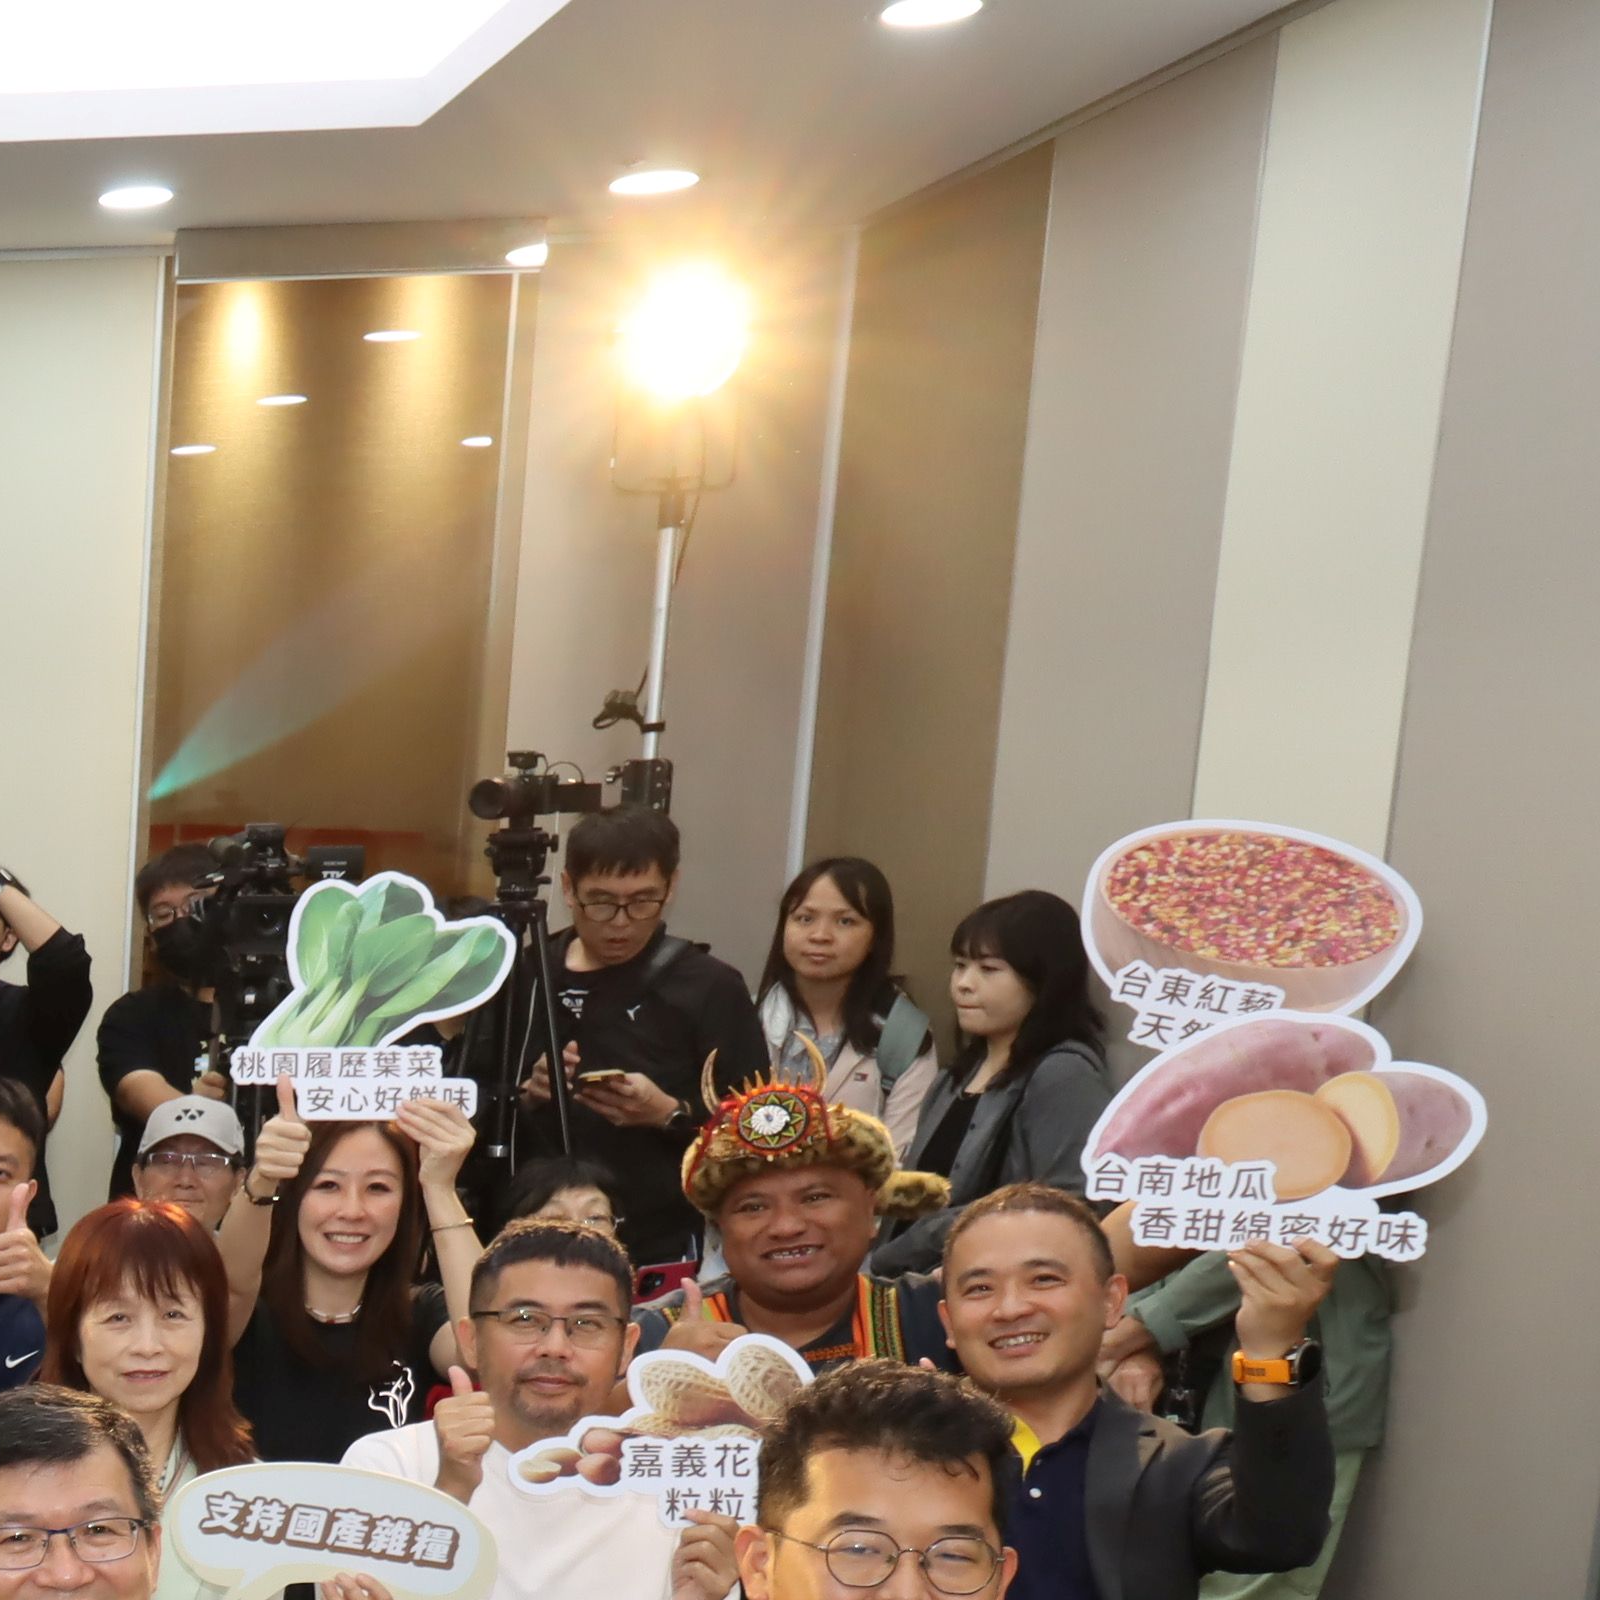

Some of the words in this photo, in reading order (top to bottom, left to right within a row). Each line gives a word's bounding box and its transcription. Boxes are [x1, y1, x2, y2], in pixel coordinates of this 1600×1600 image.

[237, 1051, 437, 1079] 桃園履歷葉菜
[1095, 1160, 1268, 1201] 台南地瓜
[1139, 1206, 1419, 1255] 香甜綿密好味
[628, 1443, 751, 1479] 嘉義花
[665, 1487, 758, 1522] 粒粒
[199, 1492, 459, 1569] 支持國產雜糧
